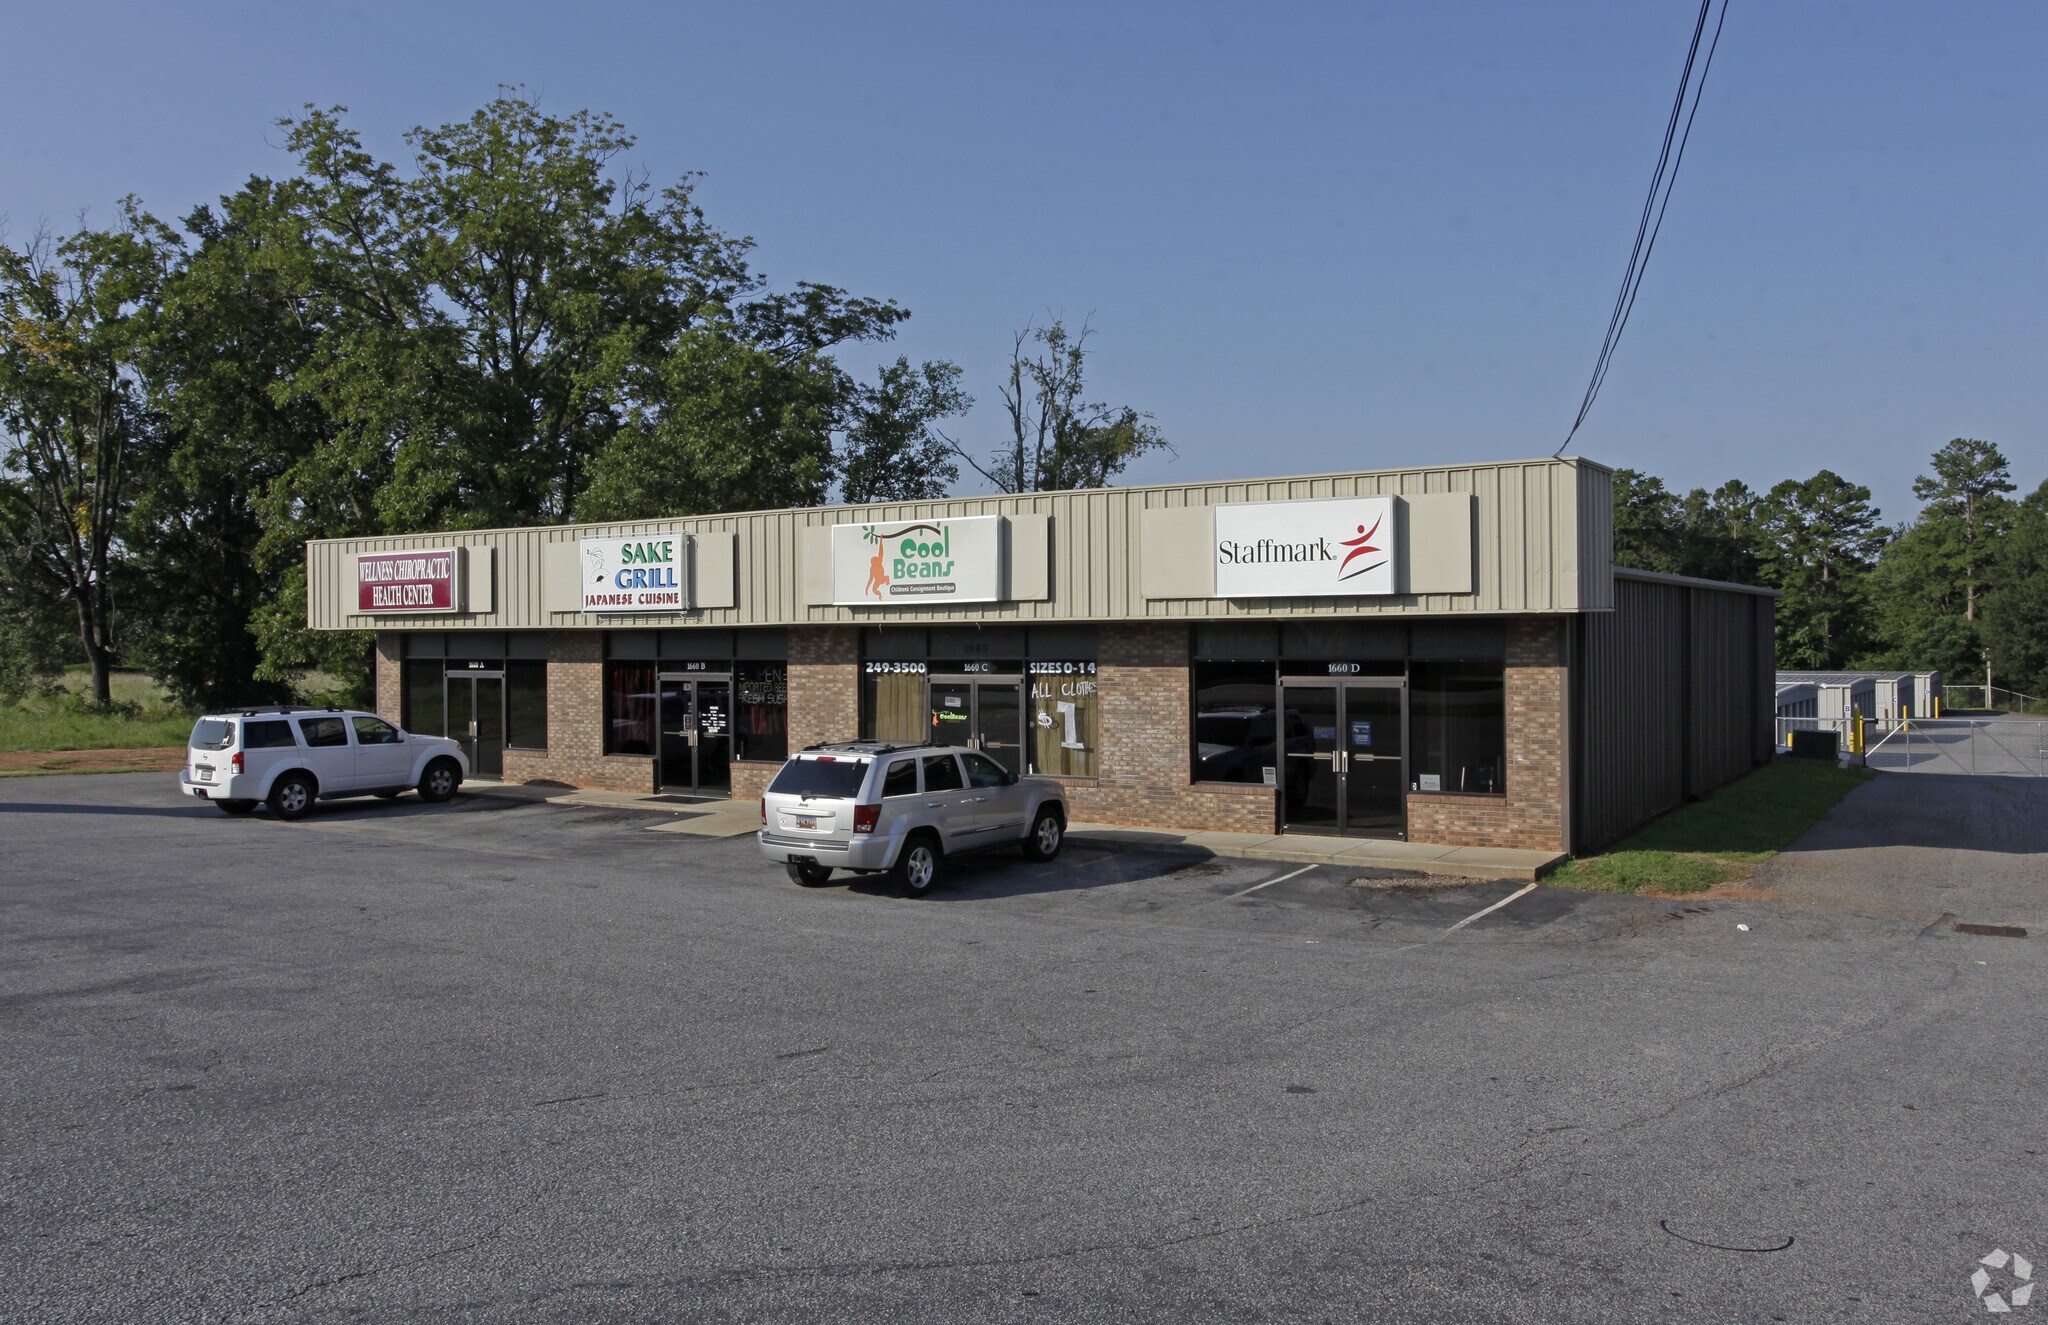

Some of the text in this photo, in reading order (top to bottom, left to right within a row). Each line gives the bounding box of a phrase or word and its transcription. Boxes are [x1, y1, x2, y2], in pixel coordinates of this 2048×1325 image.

[900, 526, 950, 559] Cool
[1219, 537, 1333, 565] Staffmark
[621, 541, 673, 565] SAKE
[359, 558, 450, 582] WELLNESS CHIROPRACTIC
[893, 559, 955, 579] Beans
[614, 567, 678, 589] GRILL
[373, 584, 434, 606] HEALTH CENTER
[585, 592, 680, 608] JAPANESE CUISINE
[700, 662, 706, 670] B
[866, 662, 926, 673] 249-3500
[964, 663, 989, 672] 1660 C
[1029, 662, 1062, 674] SIZES
[1328, 663, 1360, 673] 1660 D
[738, 693, 765, 704] FRESH
[1031, 682, 1052, 699] ALL
